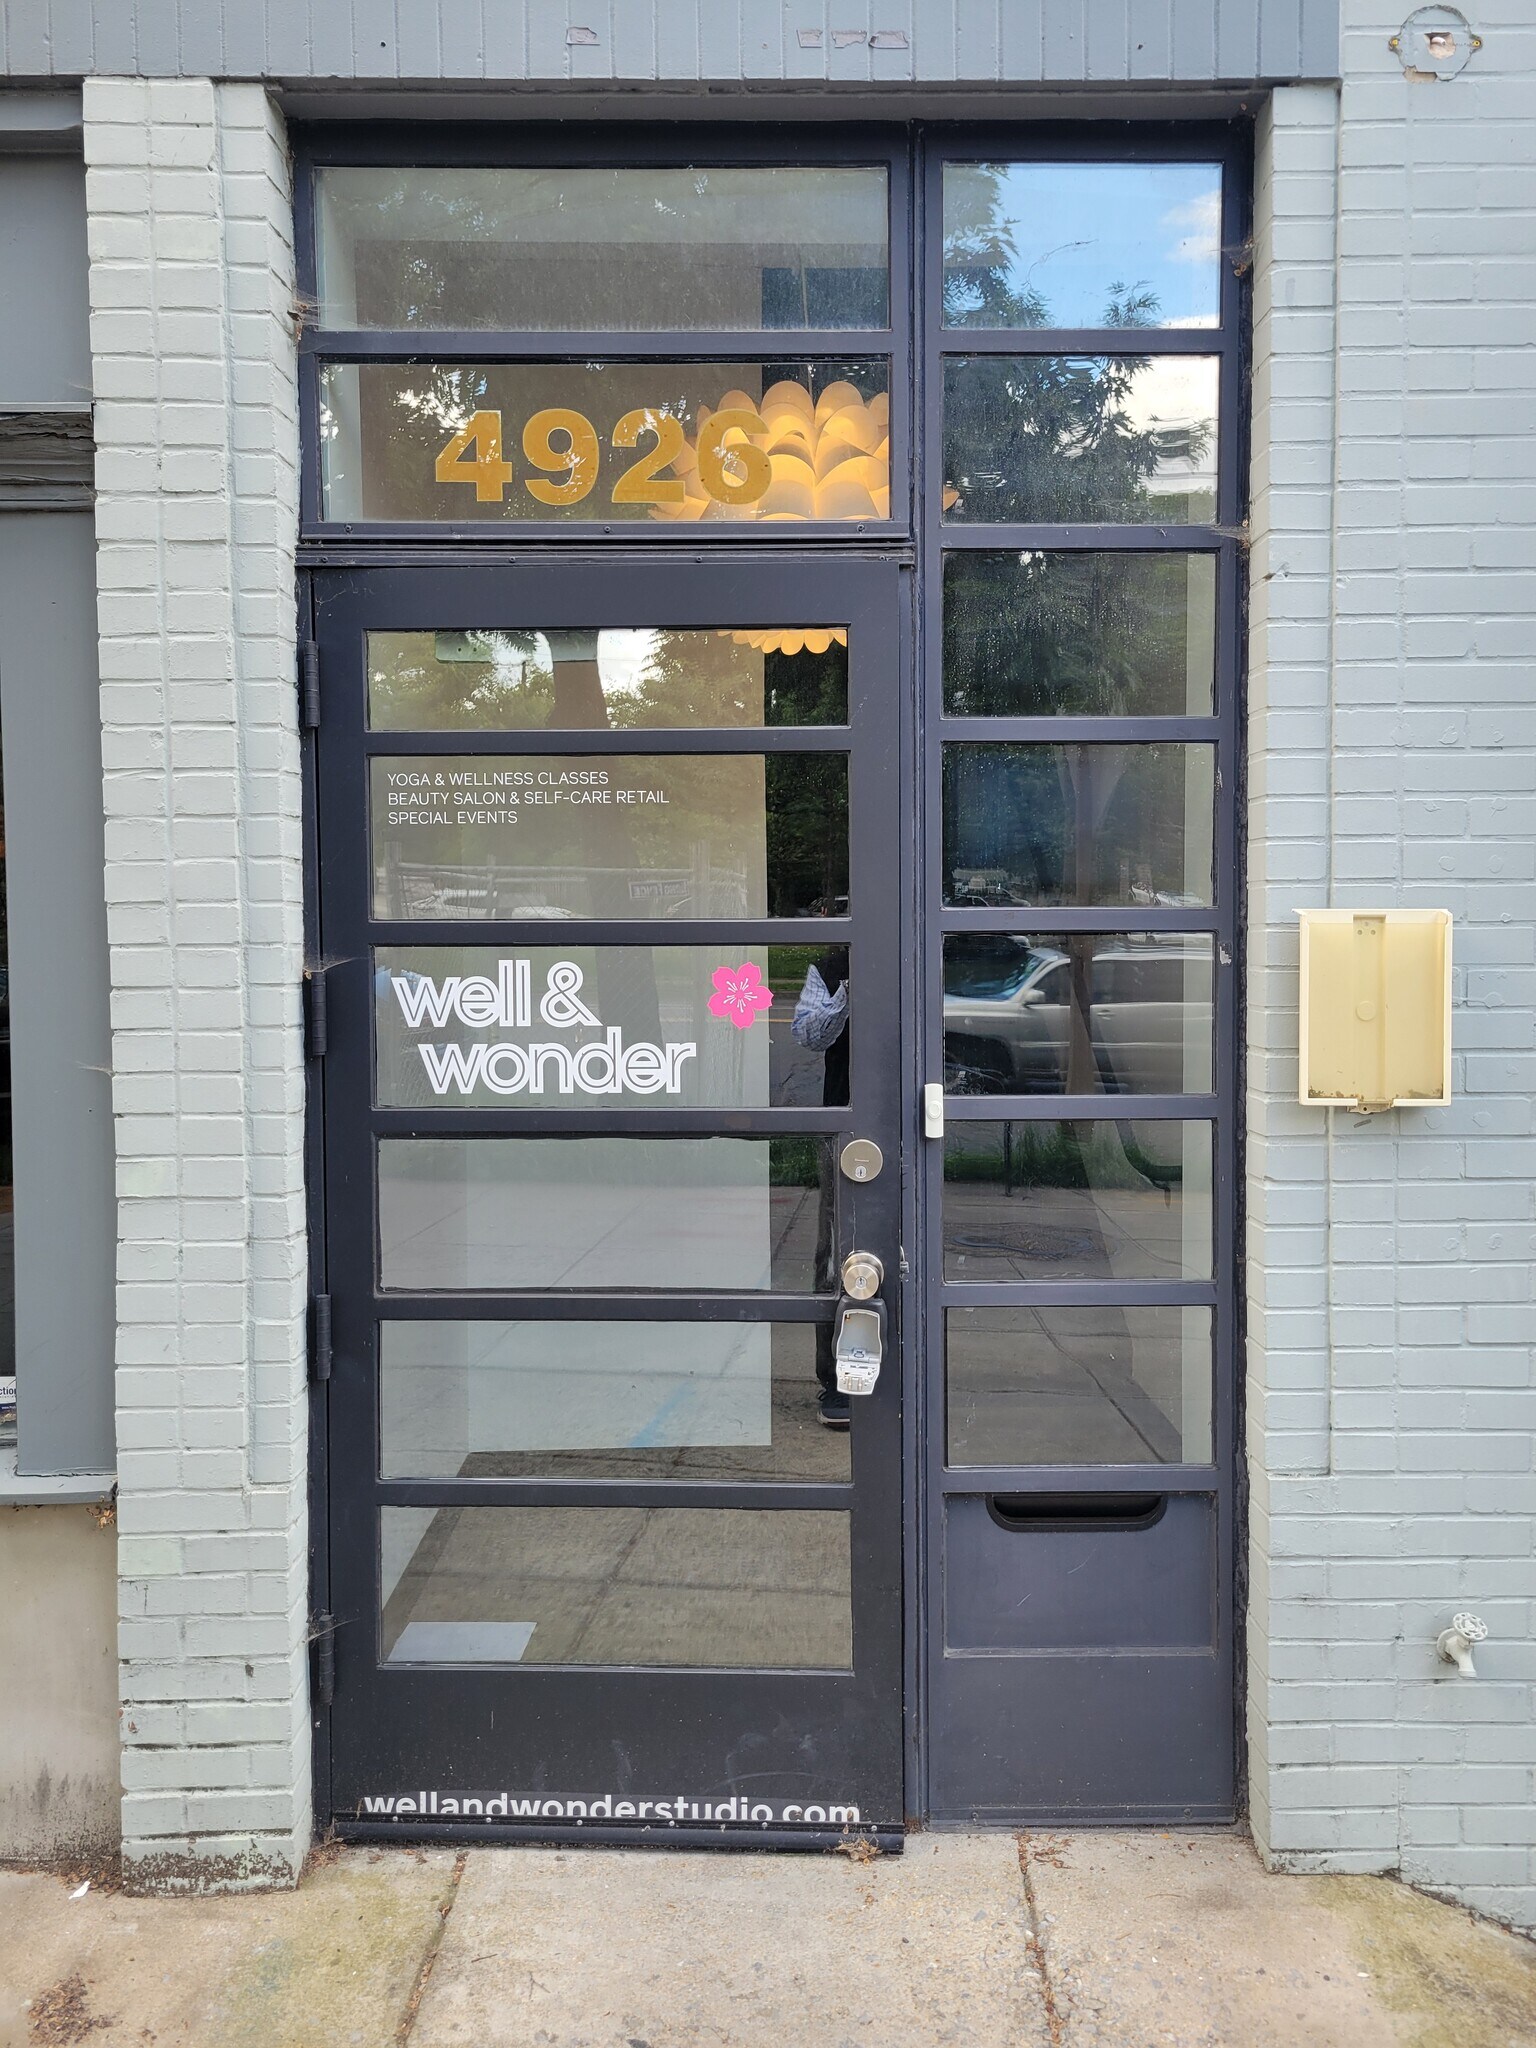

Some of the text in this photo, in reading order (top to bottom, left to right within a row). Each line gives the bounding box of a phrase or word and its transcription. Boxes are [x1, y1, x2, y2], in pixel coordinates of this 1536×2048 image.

[435, 407, 773, 506] 4926
[387, 771, 609, 787] YOGA & WELLNESS CLASSES
[388, 790, 670, 806] BEAUTY SALON & SELF-CARE RETAIL
[388, 810, 518, 825] SPECIAL EVENTS
[390, 959, 604, 1028] well &
[417, 1026, 697, 1095] wonder
[363, 1790, 862, 1824] wellandwonderstudiocom
